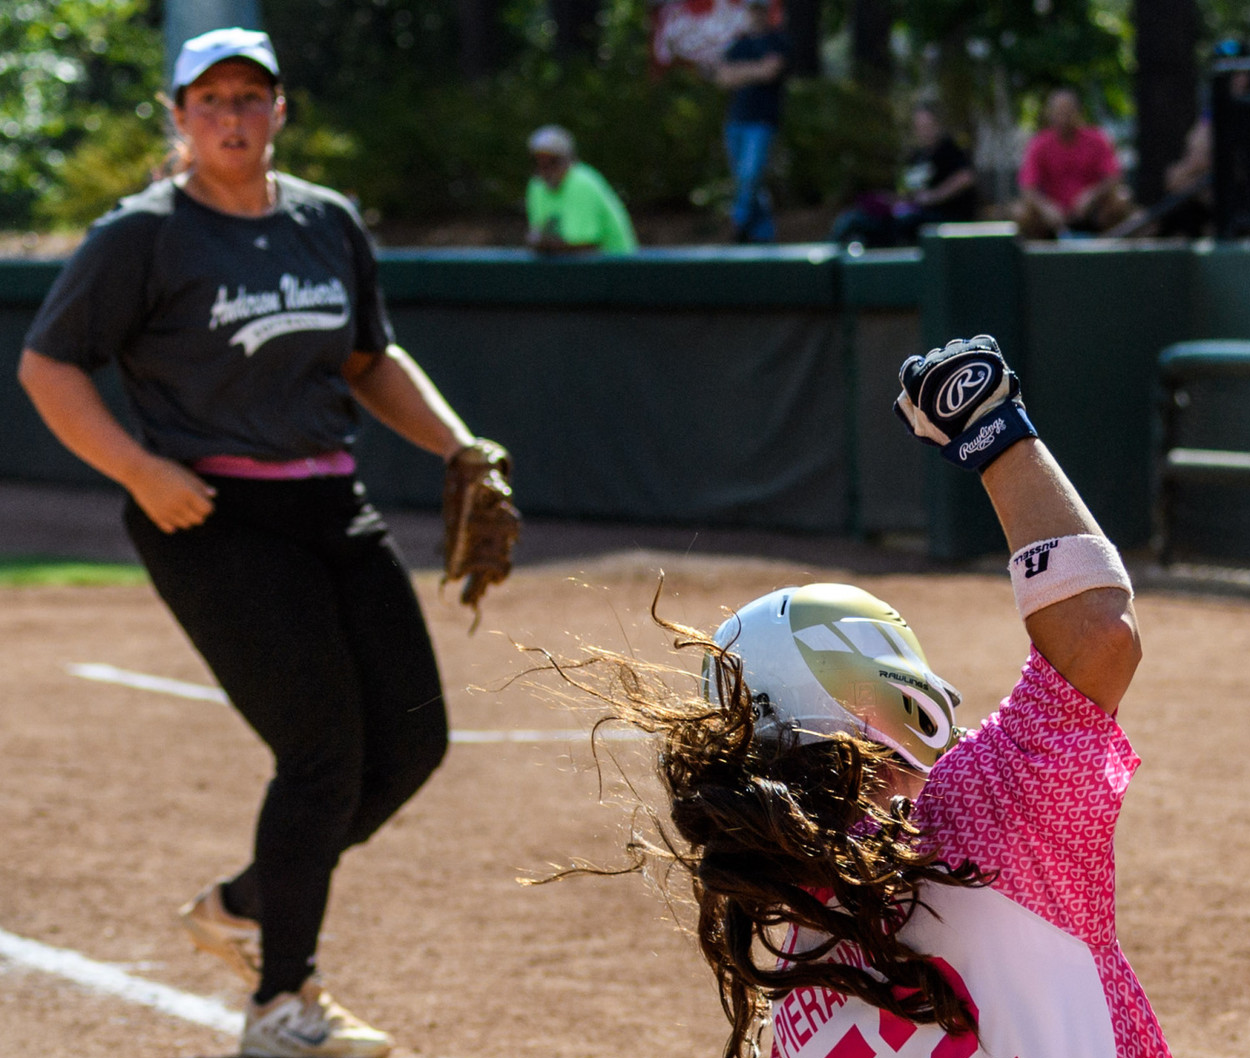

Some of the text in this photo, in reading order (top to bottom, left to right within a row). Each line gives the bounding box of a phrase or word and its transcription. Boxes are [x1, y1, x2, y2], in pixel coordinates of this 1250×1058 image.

[958, 417, 1006, 461] Rawlings
[1013, 539, 1059, 566] RUSSELL
[878, 669, 929, 691] RAWLINGS
